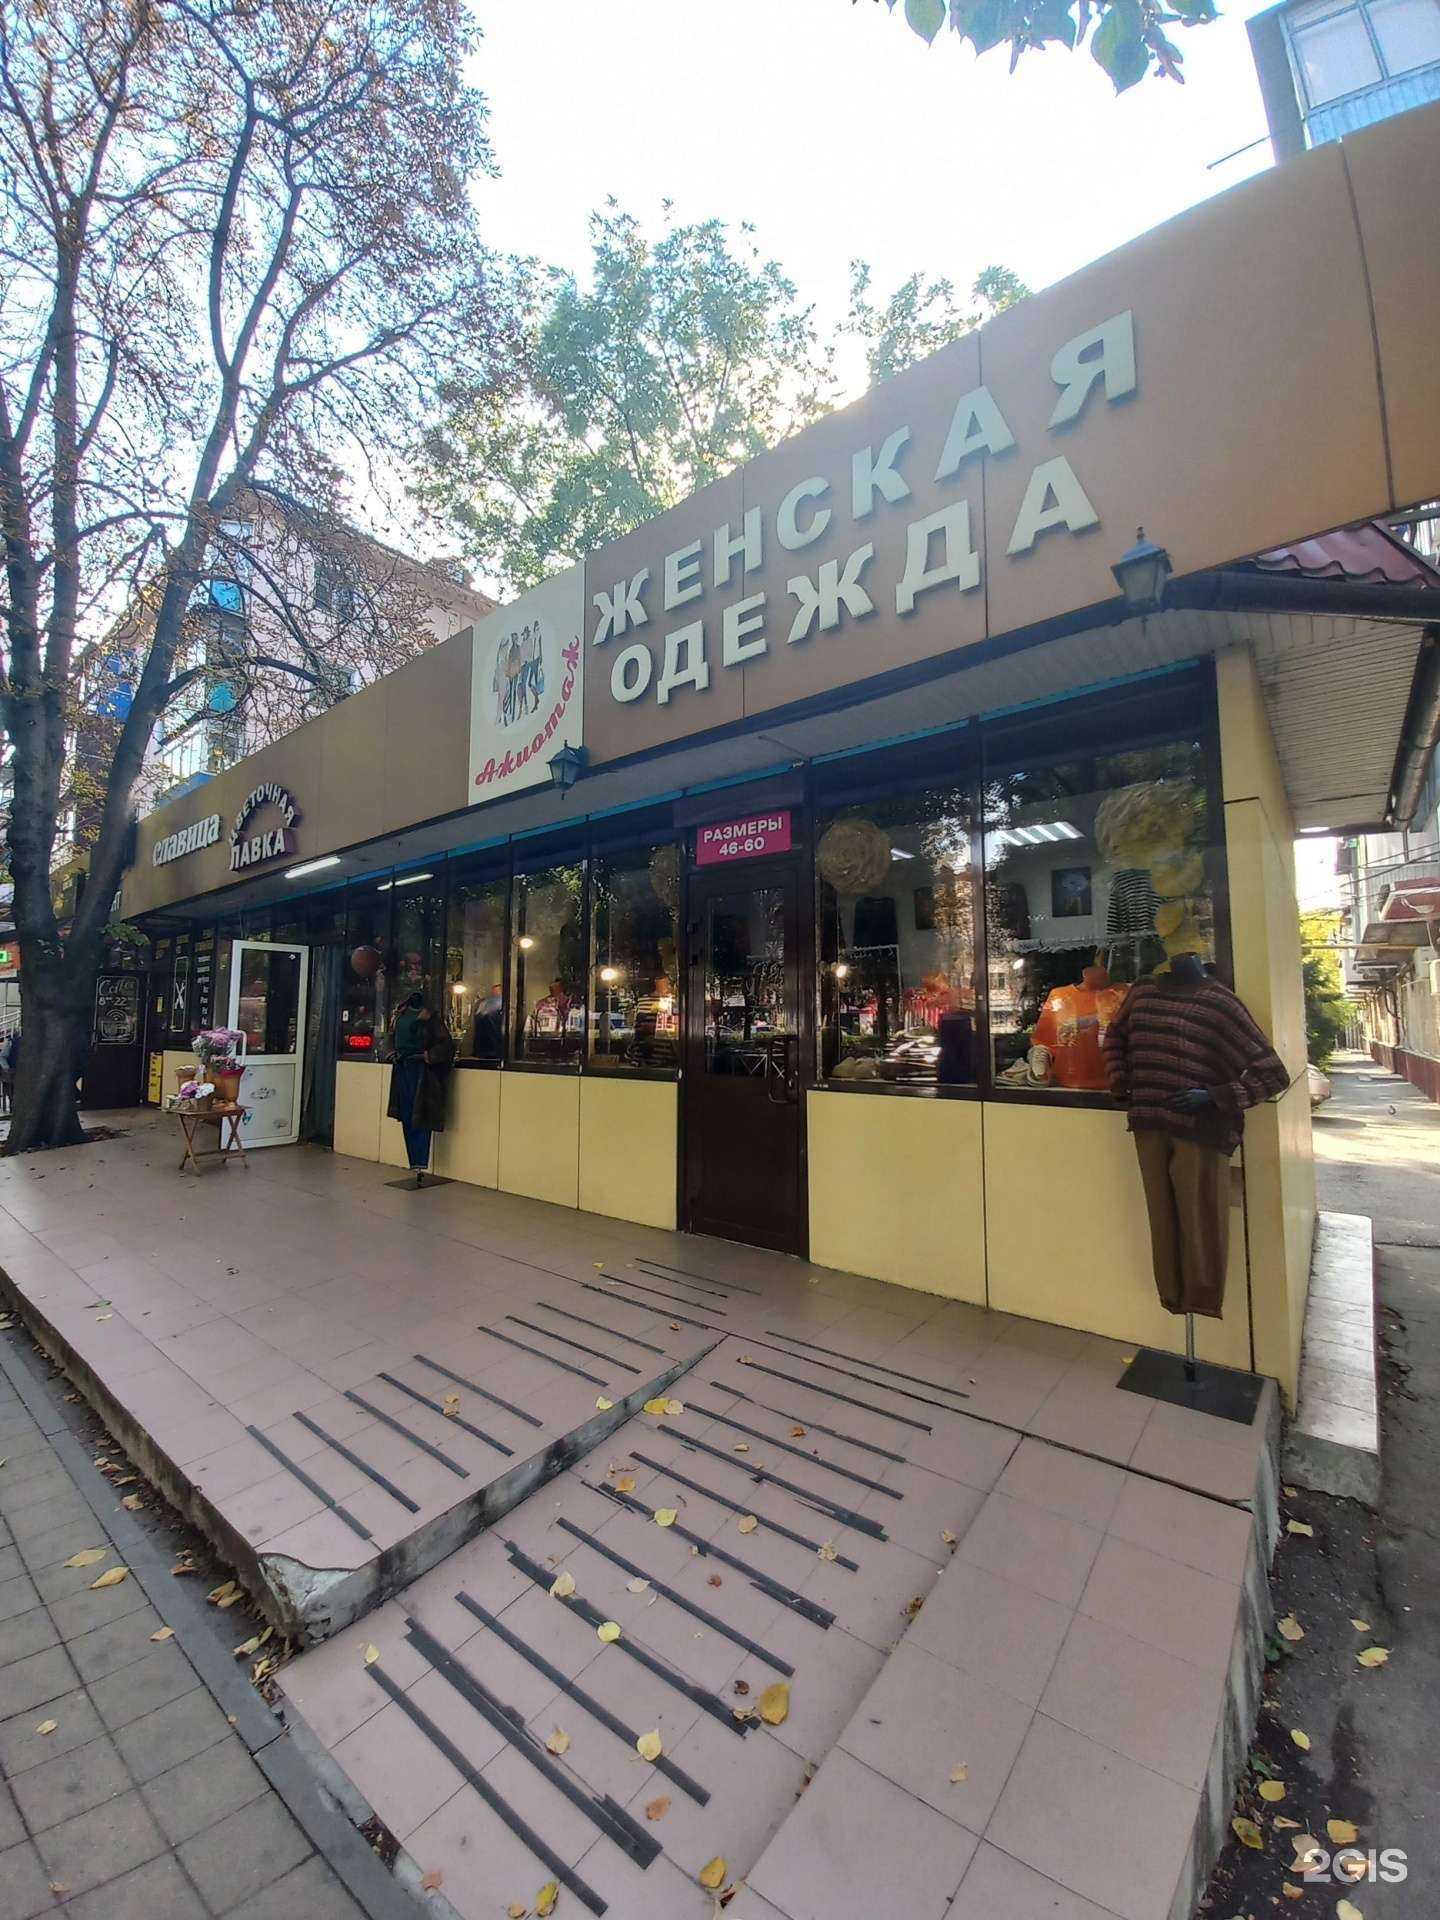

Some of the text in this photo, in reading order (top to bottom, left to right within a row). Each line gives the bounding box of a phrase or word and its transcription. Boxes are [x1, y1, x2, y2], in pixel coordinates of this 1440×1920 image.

[592, 309, 1136, 645] ЖЕНСКАЯ
[610, 455, 1099, 705] ОДЕЖДА
[475, 635, 579, 785] Ажиотаж
[229, 828, 285, 871] ЛАВКА
[704, 817, 782, 843] РАЗМЕРЫ
[719, 837, 765, 856] 46-60
